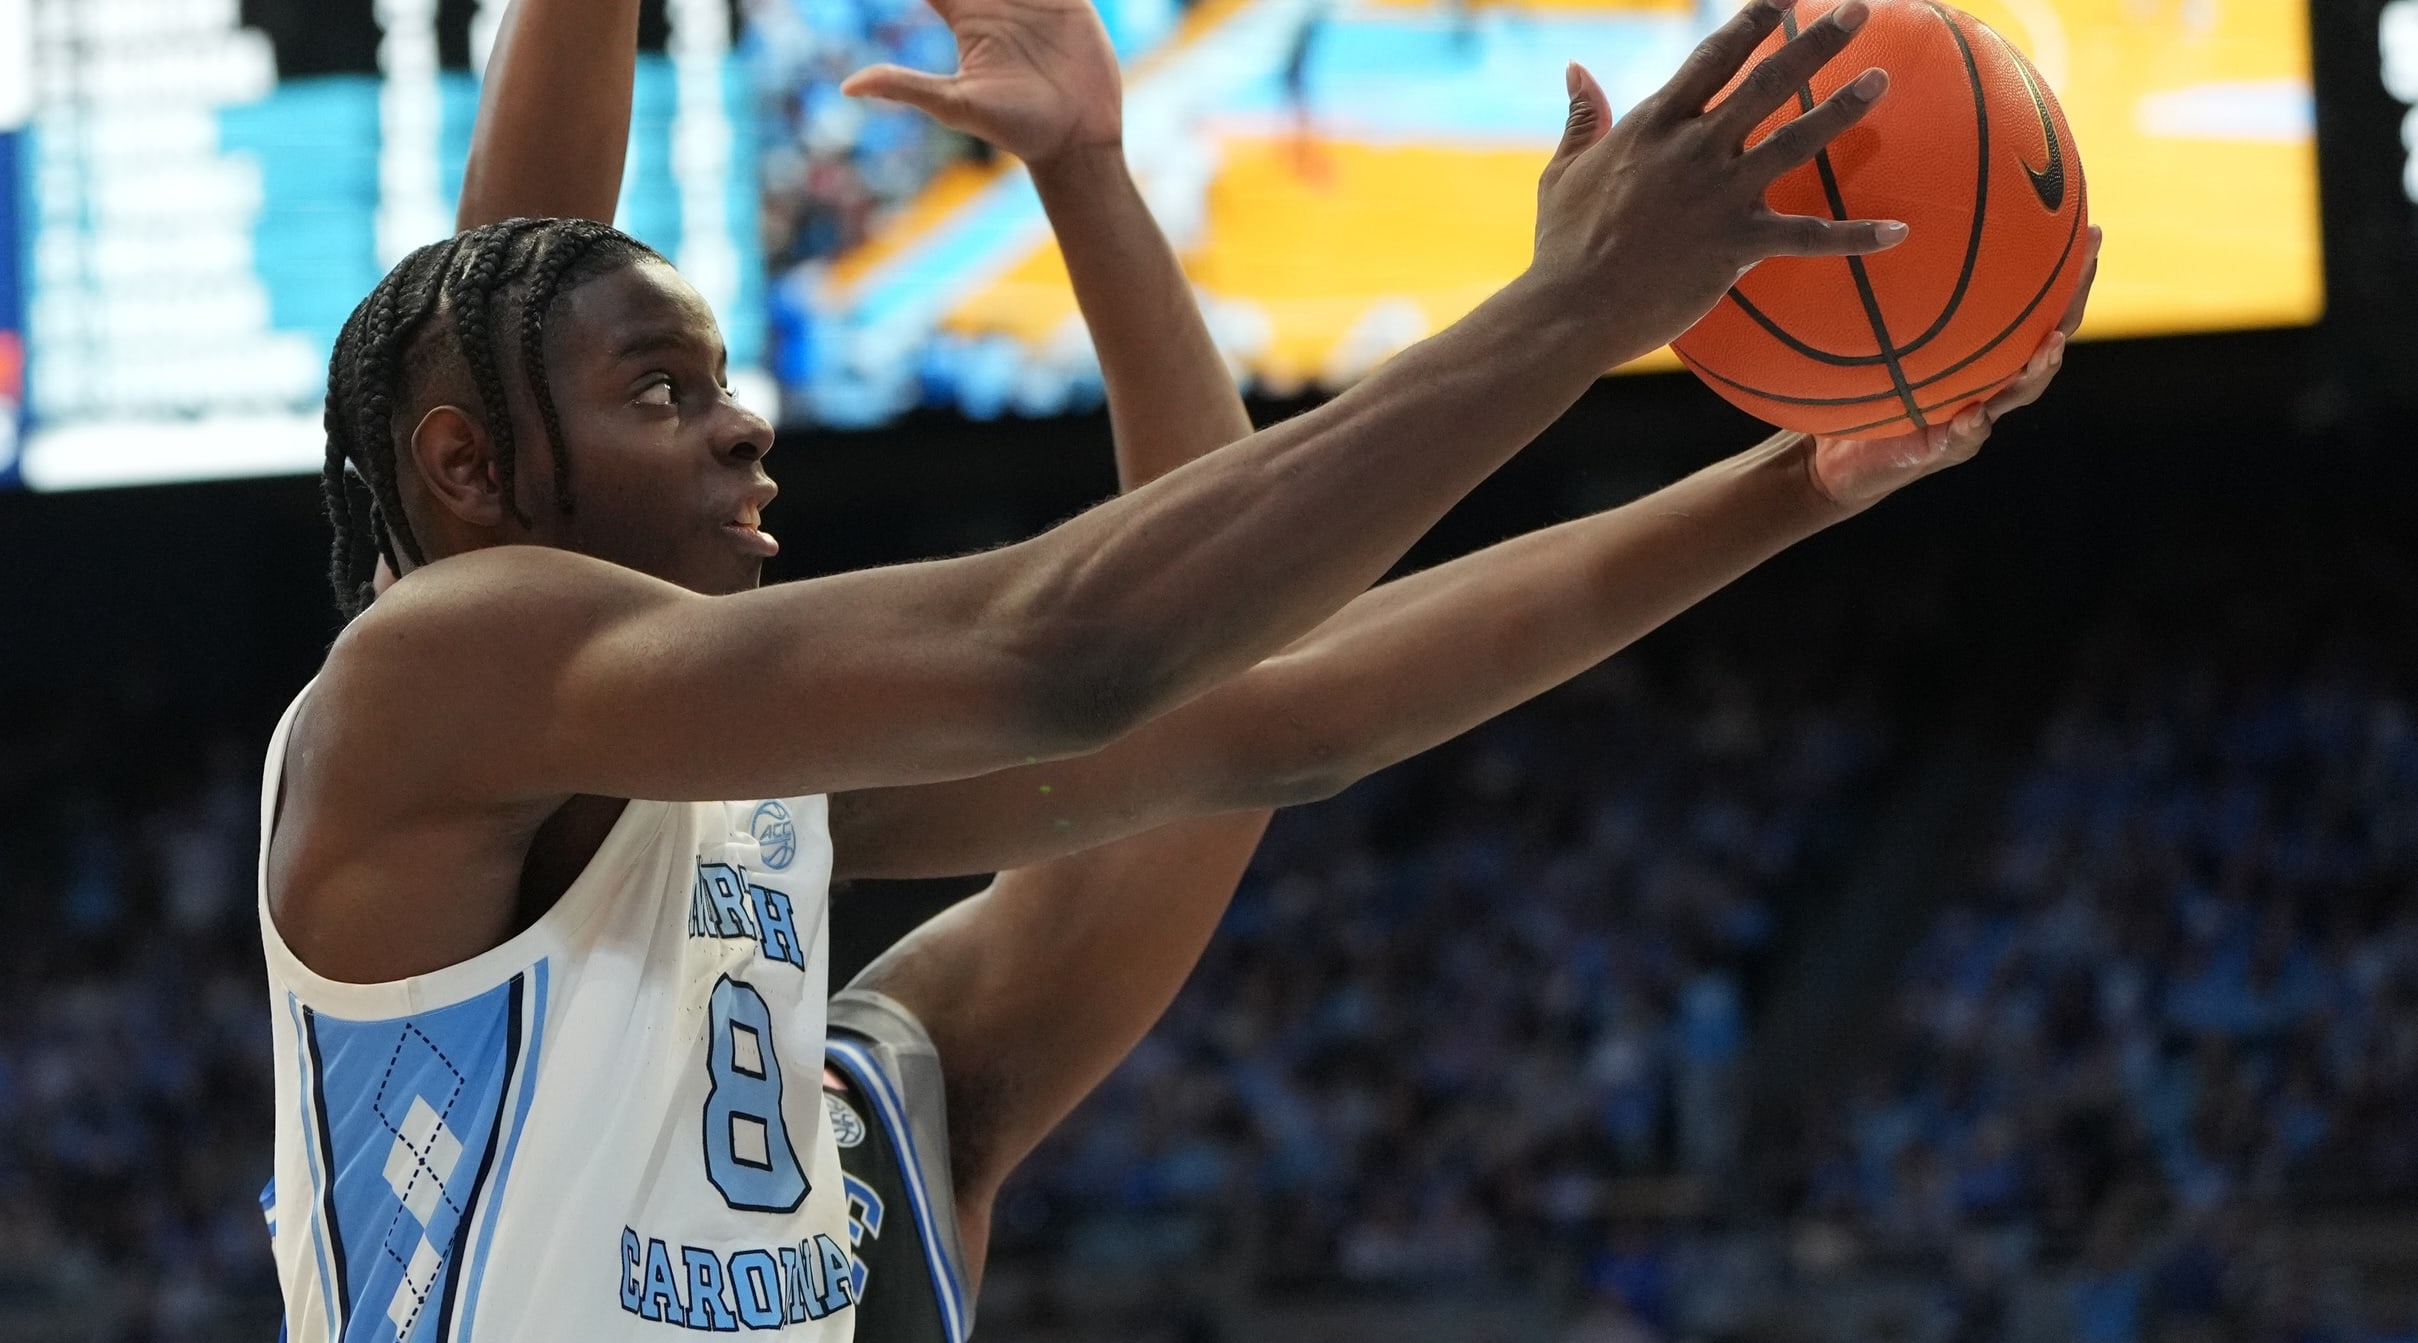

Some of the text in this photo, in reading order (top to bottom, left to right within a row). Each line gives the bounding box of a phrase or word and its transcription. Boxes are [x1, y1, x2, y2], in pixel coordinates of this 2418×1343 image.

[760, 820, 792, 841] ACC
[702, 972, 812, 1214] 8
[619, 1224, 853, 1332] CARONA
